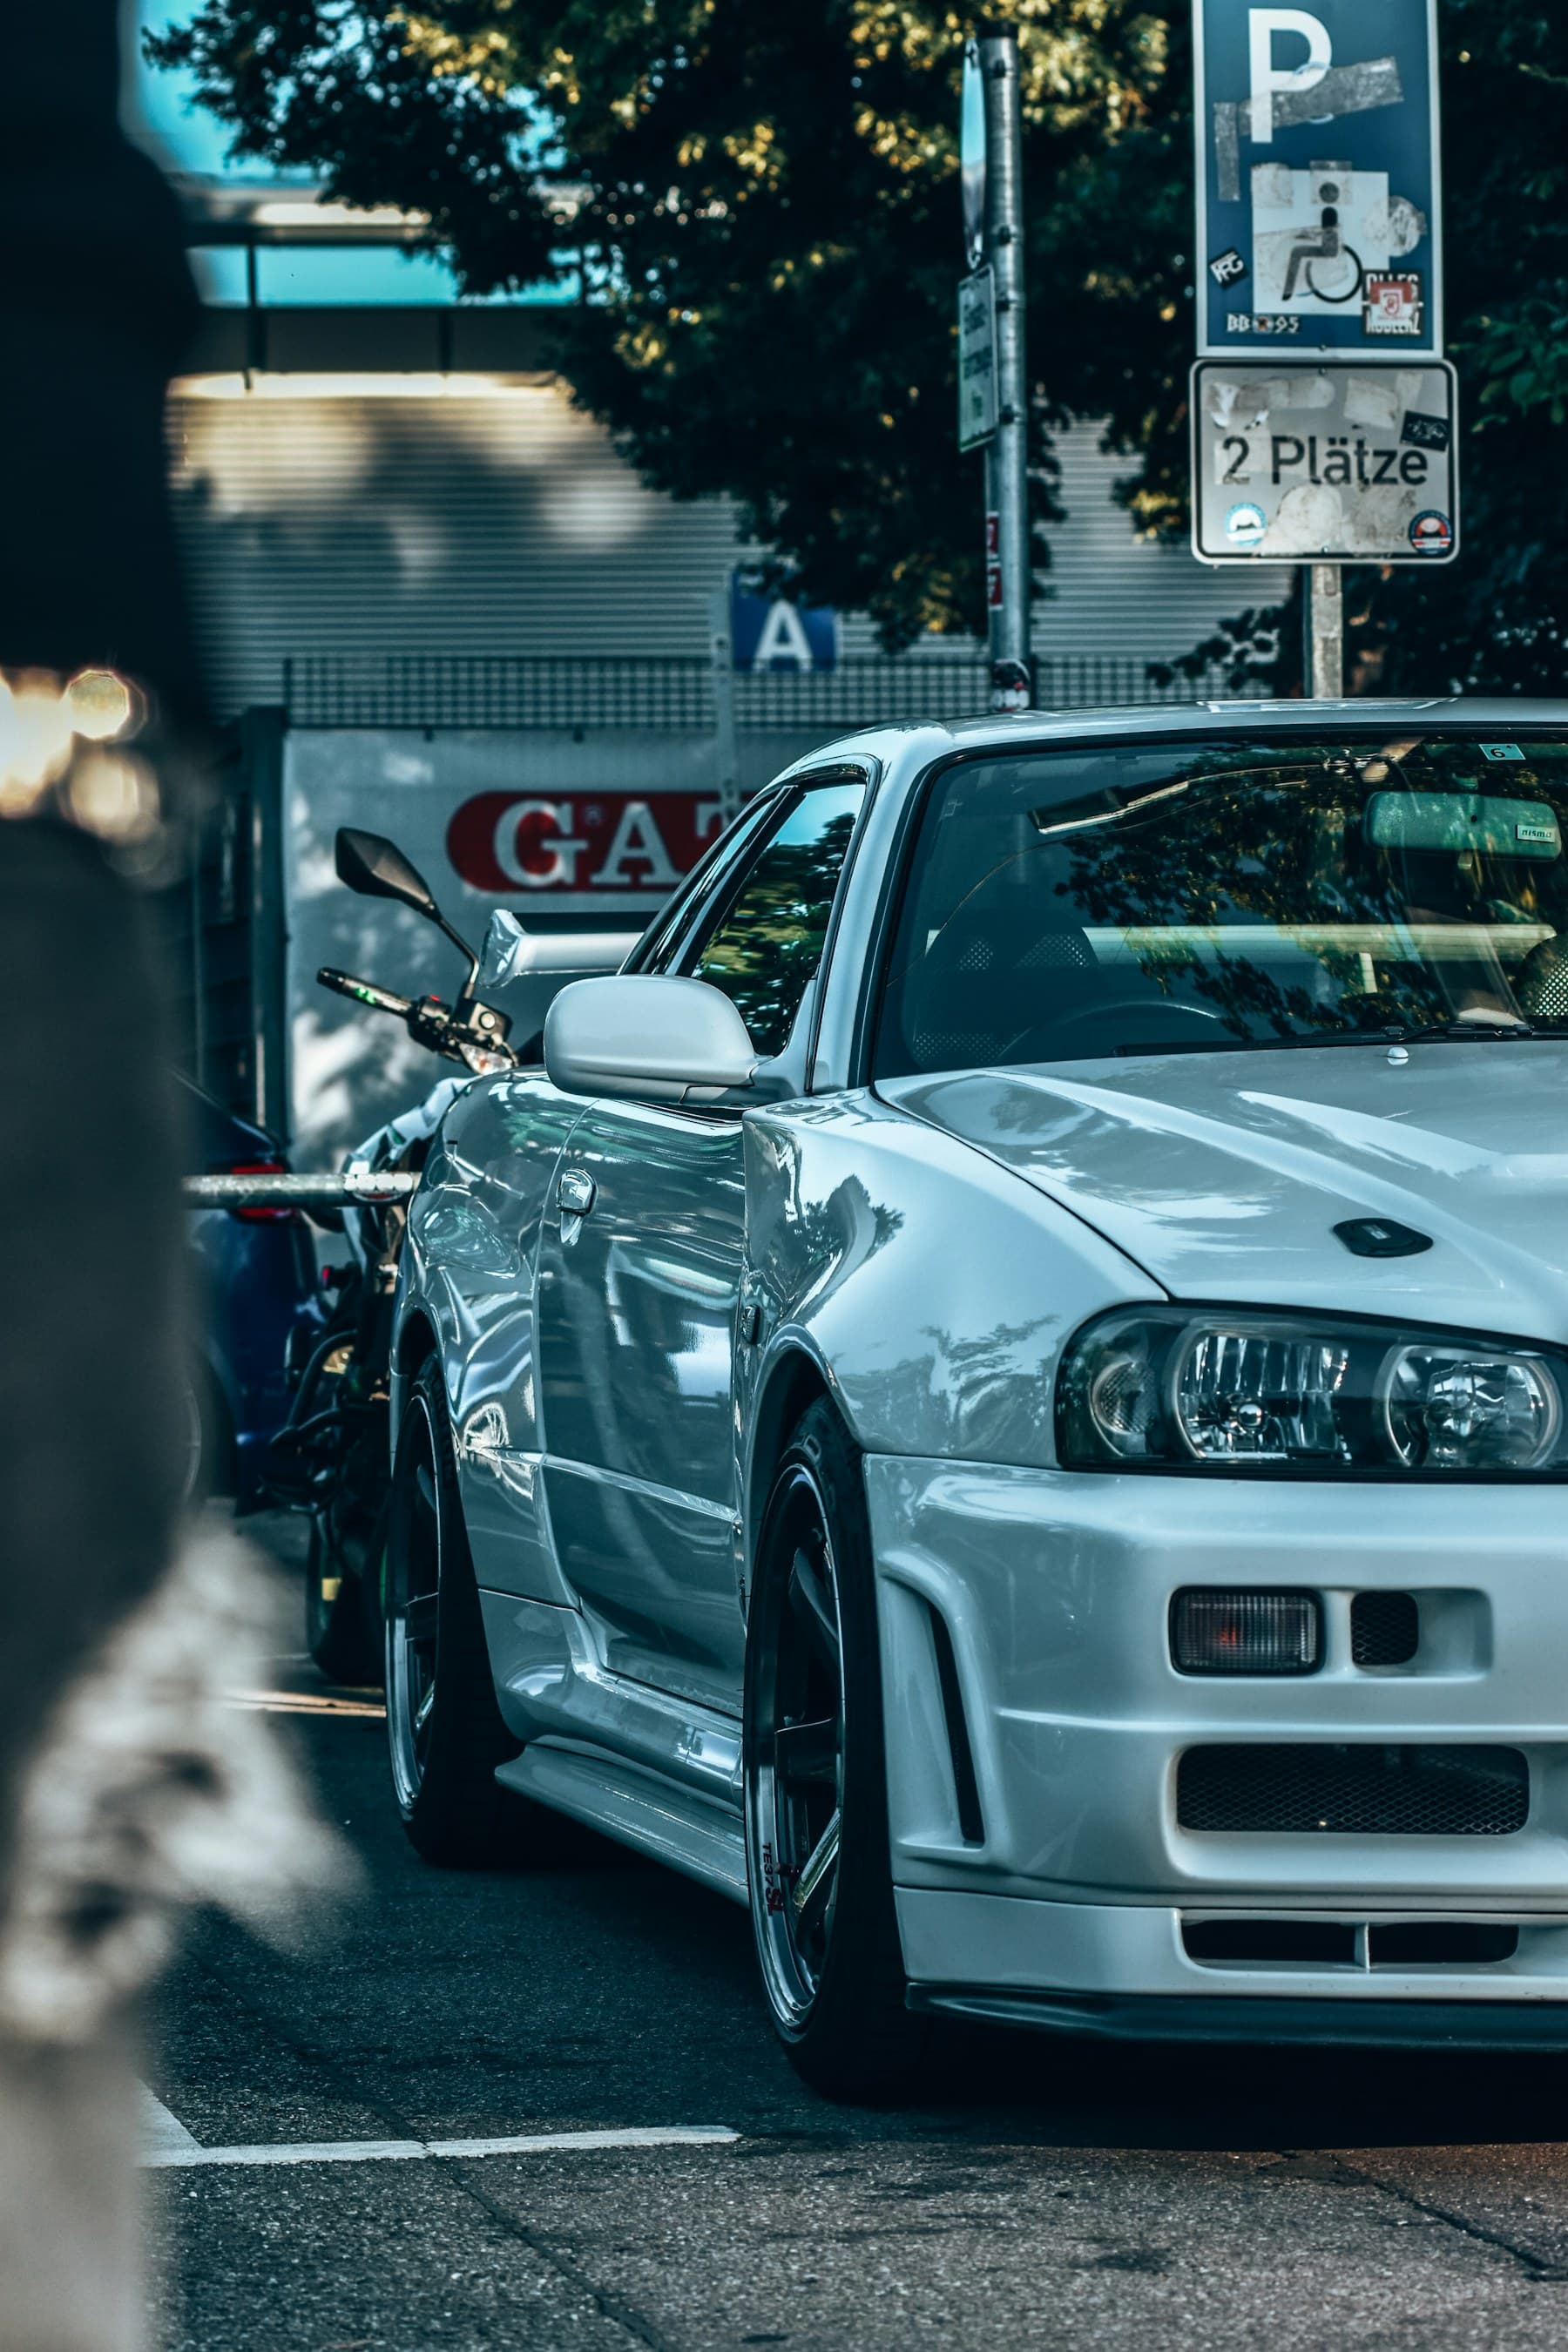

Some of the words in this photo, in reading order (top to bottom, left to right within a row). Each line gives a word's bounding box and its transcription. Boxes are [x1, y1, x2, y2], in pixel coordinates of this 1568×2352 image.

[1248, 8, 1332, 143] P
[1222, 436, 1250, 485] 2
[1271, 435, 1429, 486] Plätze
[753, 599, 815, 672] A
[1490, 747, 1506, 759] 6
